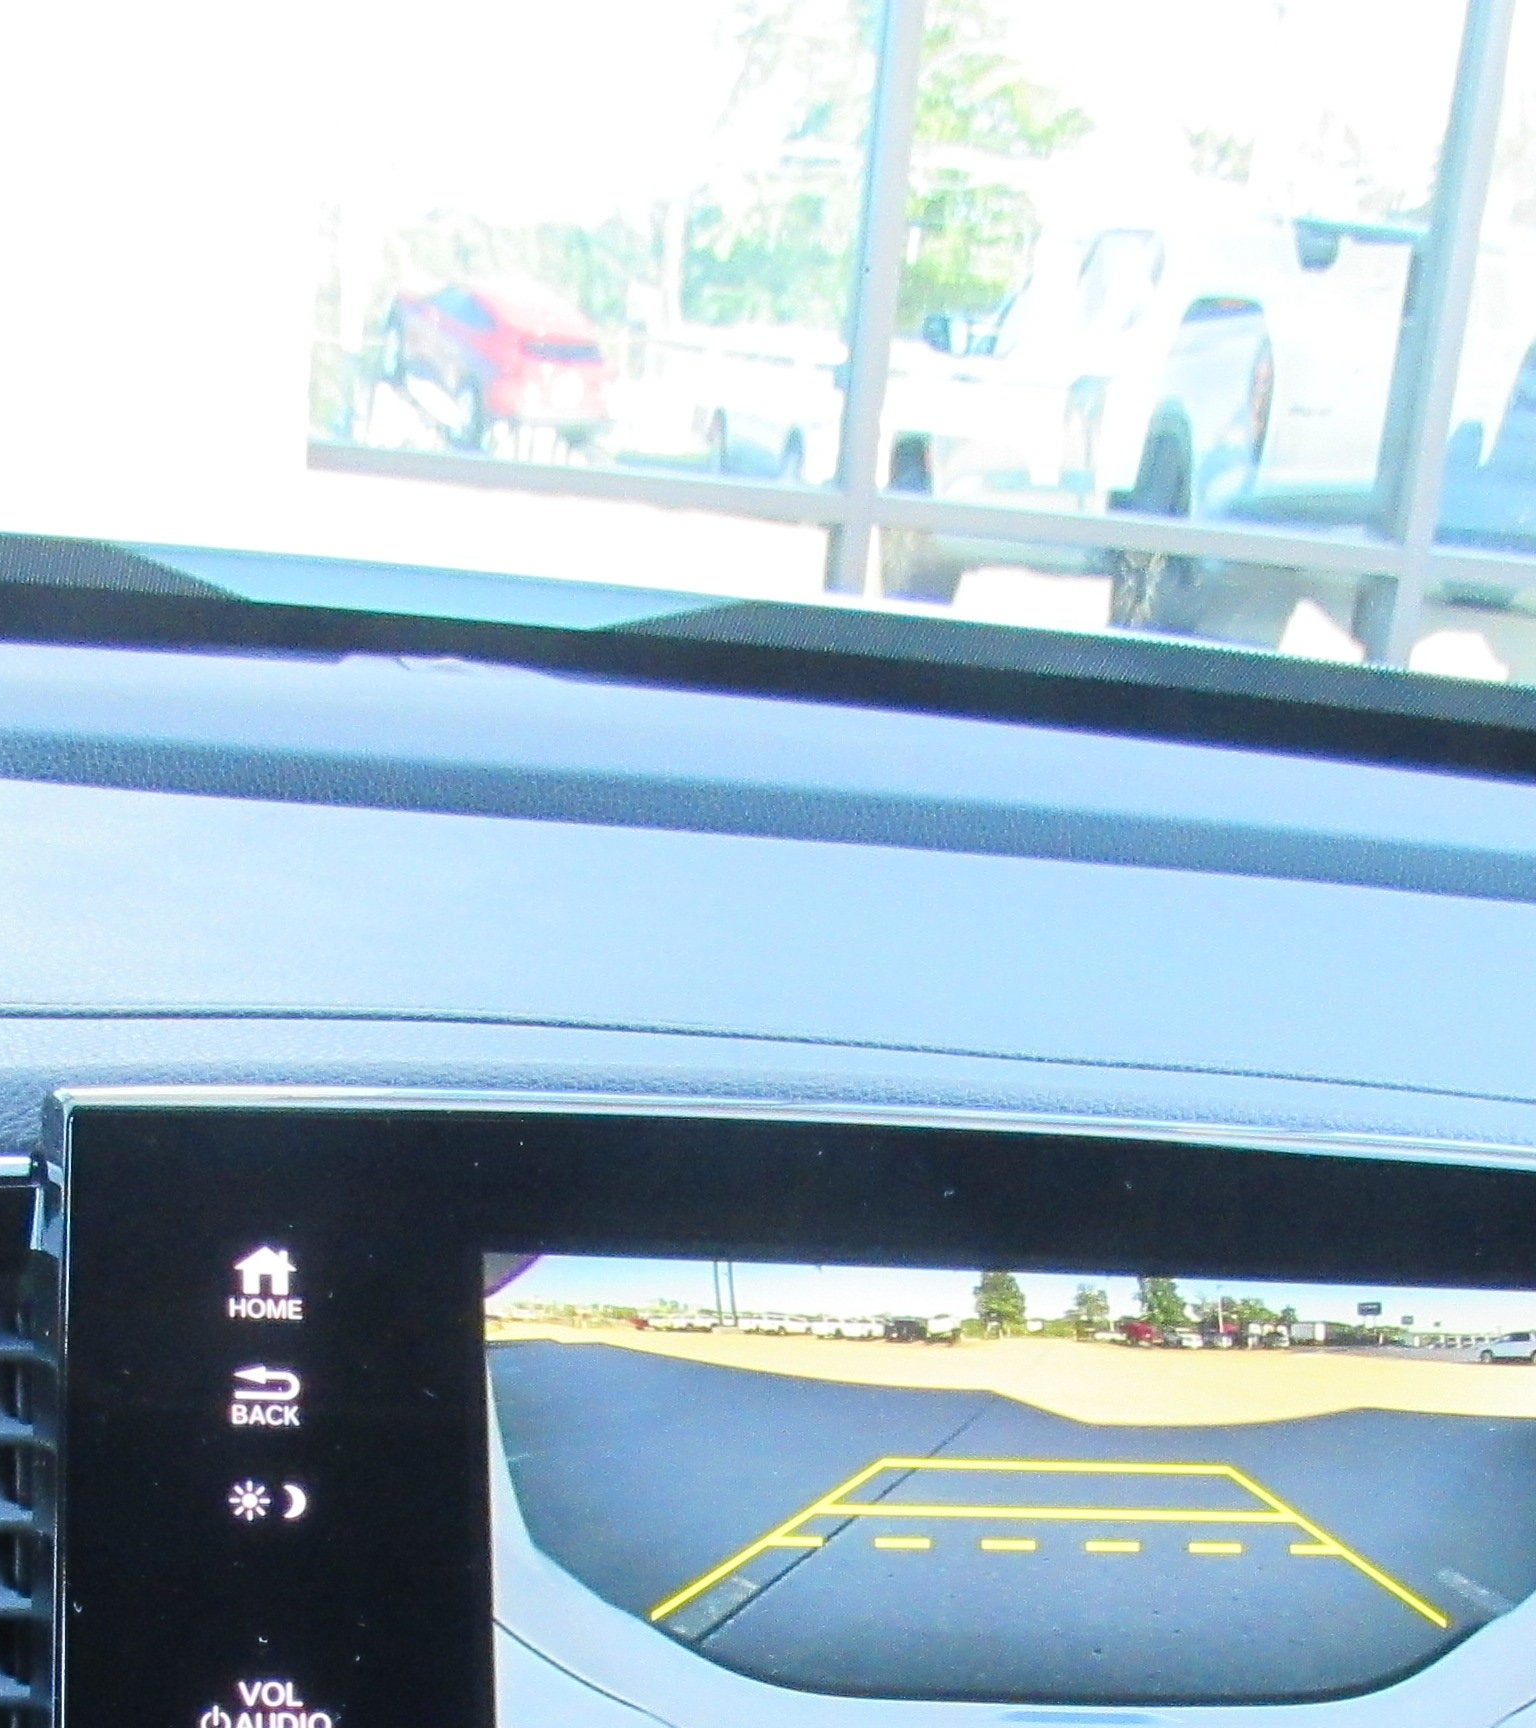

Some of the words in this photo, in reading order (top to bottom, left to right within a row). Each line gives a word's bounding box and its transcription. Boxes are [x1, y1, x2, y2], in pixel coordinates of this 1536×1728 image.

[229, 1297, 302, 1320] HOME
[231, 1402, 300, 1426] BACK
[238, 1681, 303, 1708] VOL
